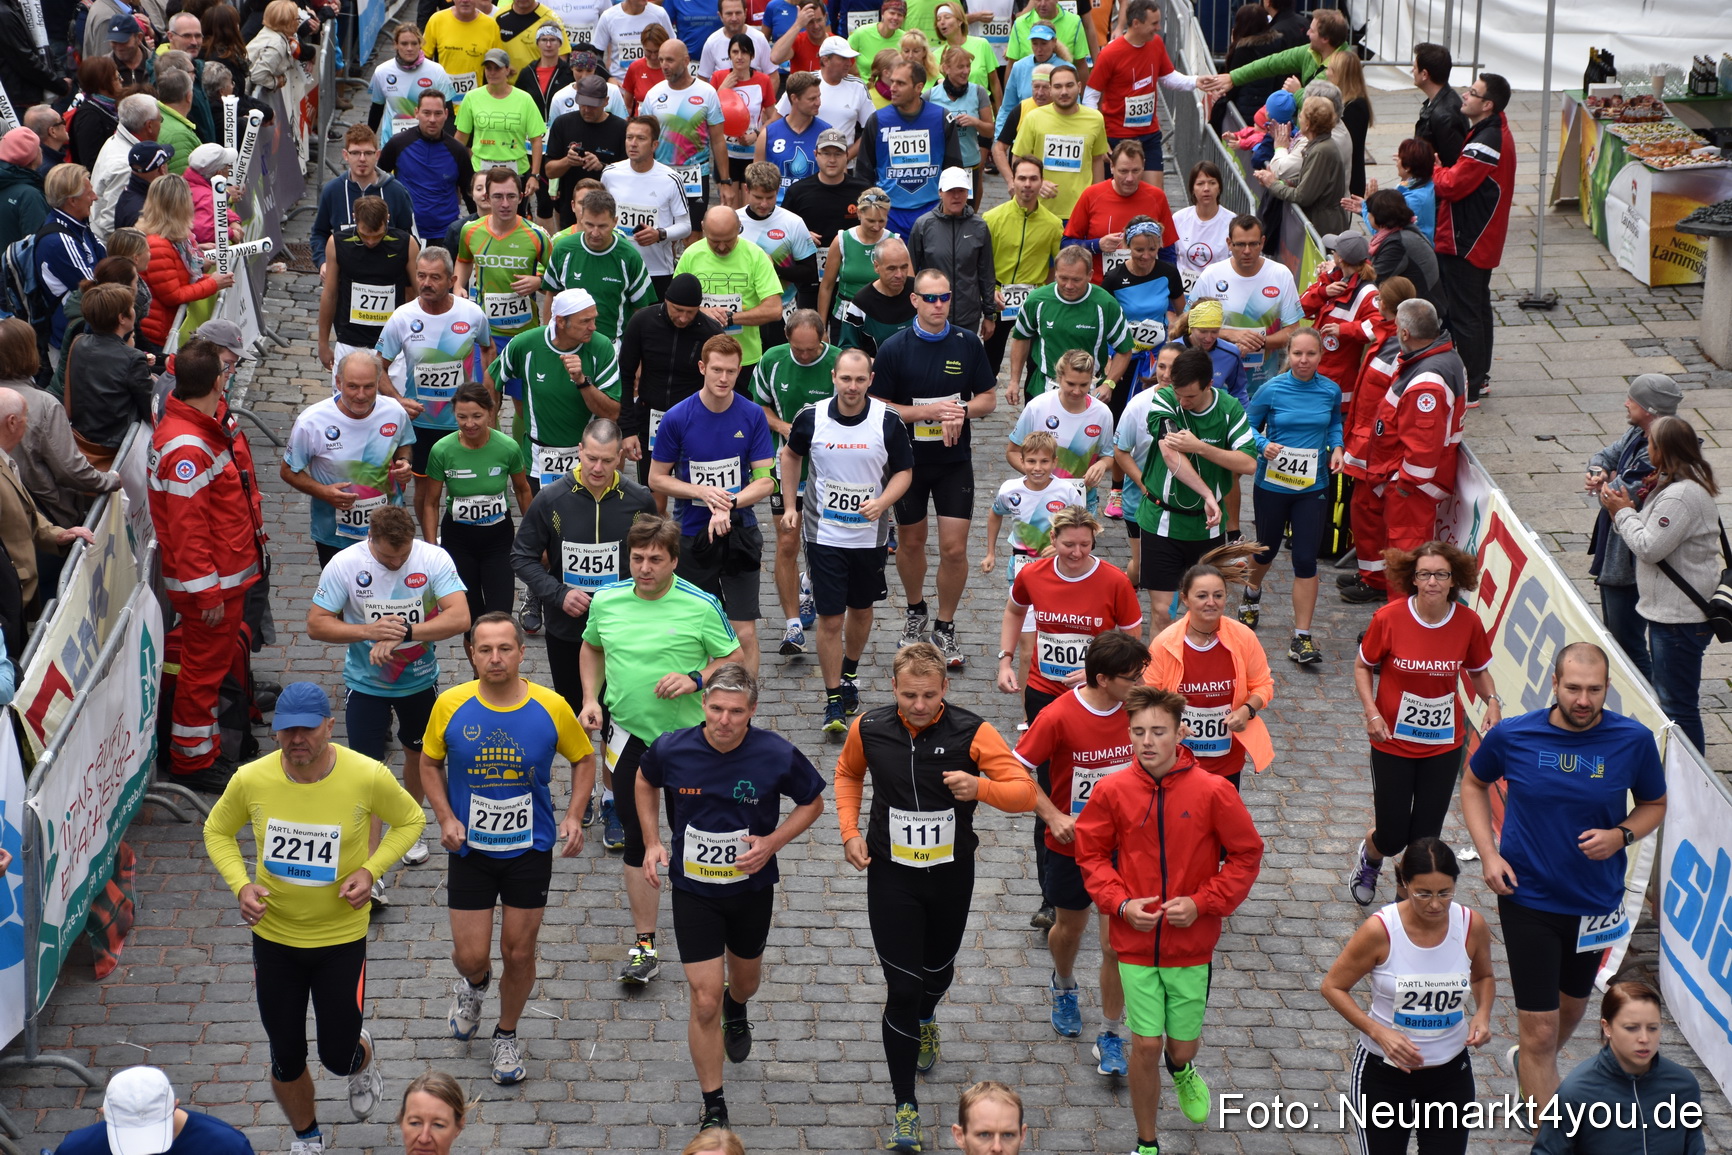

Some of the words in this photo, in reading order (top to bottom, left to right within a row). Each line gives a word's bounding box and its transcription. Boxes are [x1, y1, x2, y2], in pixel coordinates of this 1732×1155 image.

[982, 24, 1009, 36] 3056
[1129, 100, 1154, 116] 3333
[475, 111, 521, 130] OPF
[772, 138, 786, 154] 8
[893, 139, 926, 154] 2019
[1048, 143, 1080, 158] 2110
[887, 167, 937, 178] FIBALON
[216, 200, 227, 228] BMW
[620, 212, 654, 228] 3106
[475, 255, 528, 268] BOCK
[360, 294, 389, 311] 277
[490, 300, 528, 317] 2754
[358, 312, 388, 320] Sebastian
[420, 371, 460, 388] 2227
[1277, 456, 1308, 476] 244
[696, 469, 735, 486] 2511
[1274, 473, 1306, 486] Brunhilde
[458, 502, 502, 521] 2050
[834, 514, 861, 522] Andreas
[568, 554, 615, 574] 2454
[578, 577, 602, 586] Volker
[1034, 611, 1092, 626] NEUMARKT
[1394, 658, 1456, 671] NEUMARKT
[1402, 696, 1423, 707] PARTL
[1404, 706, 1451, 727] 2332
[1412, 728, 1440, 738] Kerstin
[1188, 742, 1216, 750] Sandra
[472, 799, 492, 810] PARTL
[494, 802, 523, 811] Neumarkt
[475, 808, 528, 831] 2726
[891, 813, 911, 821] PARTL
[268, 824, 291, 834] PARTL
[293, 828, 328, 838] Neumarkt
[686, 831, 705, 842] PARTL
[902, 824, 940, 846] 111
[474, 833, 526, 845] Siegamondo
[271, 836, 332, 864] 2214
[696, 844, 737, 864] 228
[914, 851, 930, 861] Kay
[287, 866, 311, 878] Hans
[699, 867, 733, 877] Thomas
[1595, 926, 1624, 943] Manuel
[1424, 980, 1459, 988] Neumarkt
[1402, 990, 1464, 1012] 2405
[1405, 1017, 1442, 1027] Barbara
